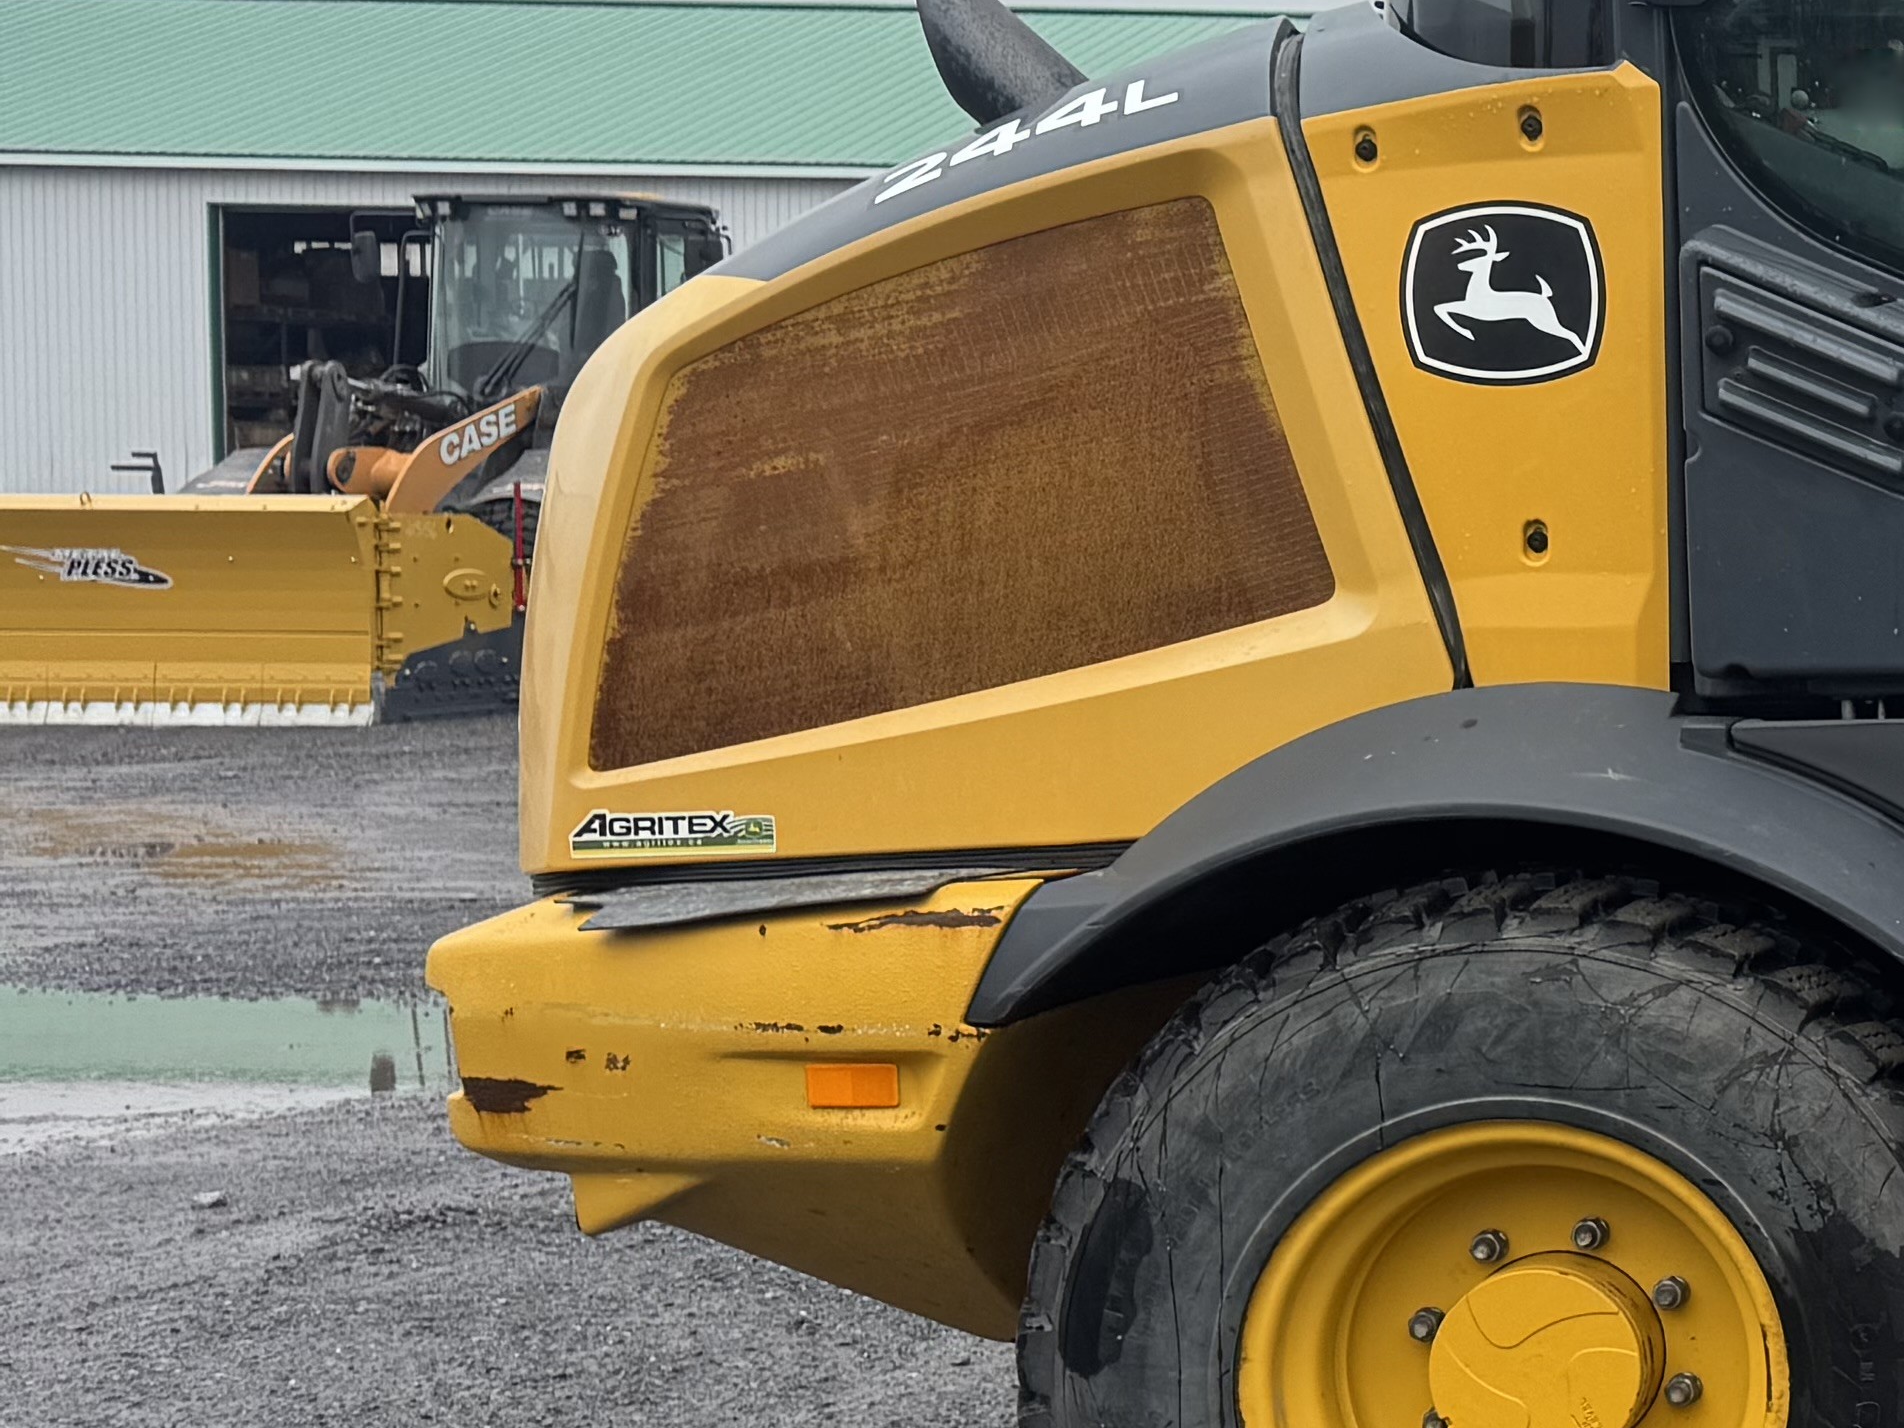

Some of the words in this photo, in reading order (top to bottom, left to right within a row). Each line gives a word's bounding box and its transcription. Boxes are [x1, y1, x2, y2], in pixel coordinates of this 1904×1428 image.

[874, 79, 1178, 205] 244L
[440, 403, 517, 465] CASE
[573, 813, 731, 838] AGRITEX
